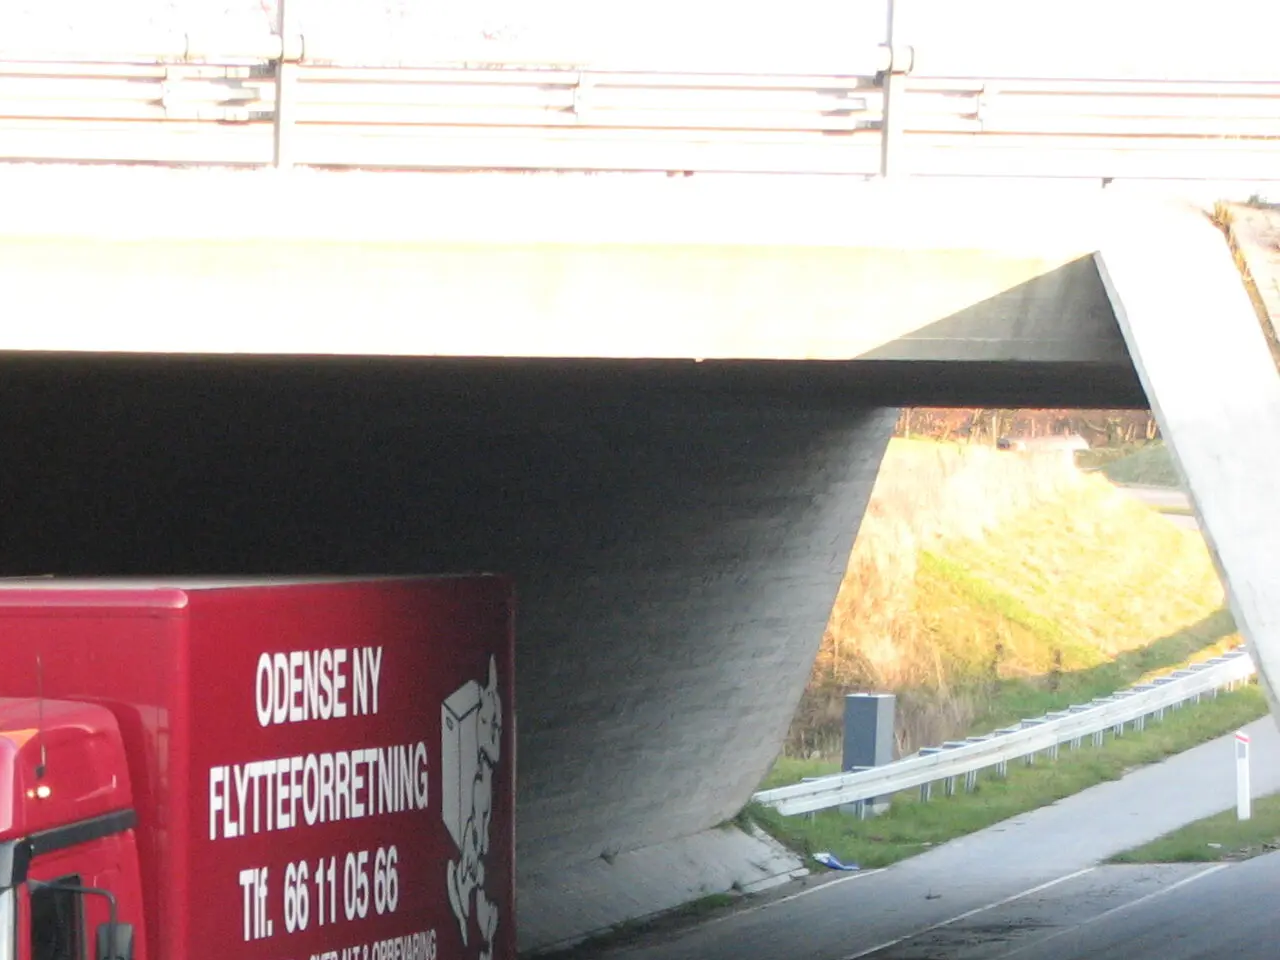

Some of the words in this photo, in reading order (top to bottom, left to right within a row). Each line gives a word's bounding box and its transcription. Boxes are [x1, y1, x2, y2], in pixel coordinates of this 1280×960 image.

[256, 648, 347, 727] ODENSE
[353, 646, 383, 716] NY
[209, 741, 428, 841] FLYTTEFORRETNING
[239, 866, 273, 941] Tlf.
[284, 860, 309, 933] 66
[315, 856, 336, 926] 11
[344, 852, 369, 921] 05
[374, 845, 399, 915] 66
